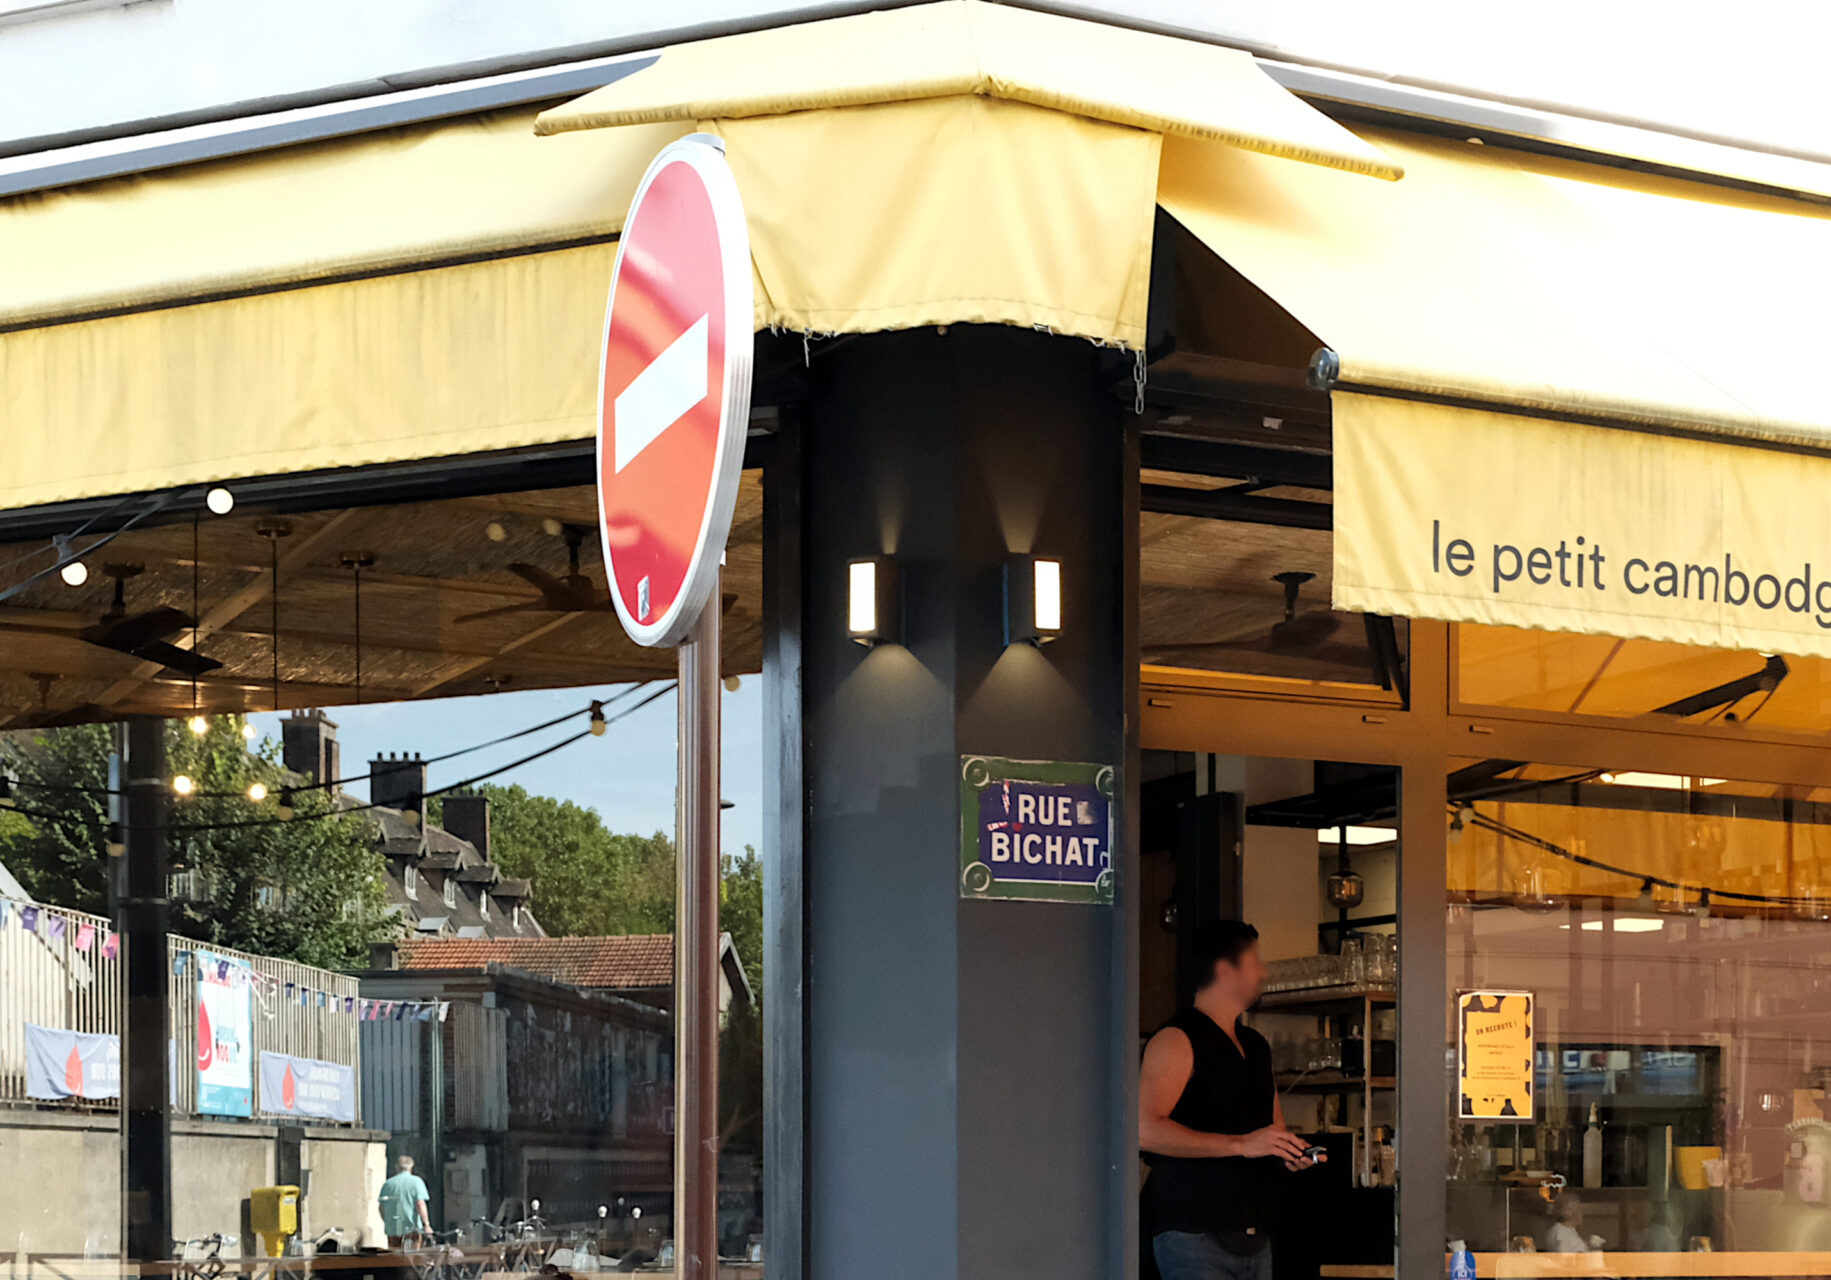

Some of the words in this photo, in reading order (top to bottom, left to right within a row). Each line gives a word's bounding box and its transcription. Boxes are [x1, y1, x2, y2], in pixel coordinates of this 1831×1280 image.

[1433, 520, 1475, 577] le
[1493, 536, 1606, 593] petit
[1624, 553, 1831, 629] cambodg
[1018, 793, 1073, 827] RUE
[991, 831, 1100, 867] BICHAT
